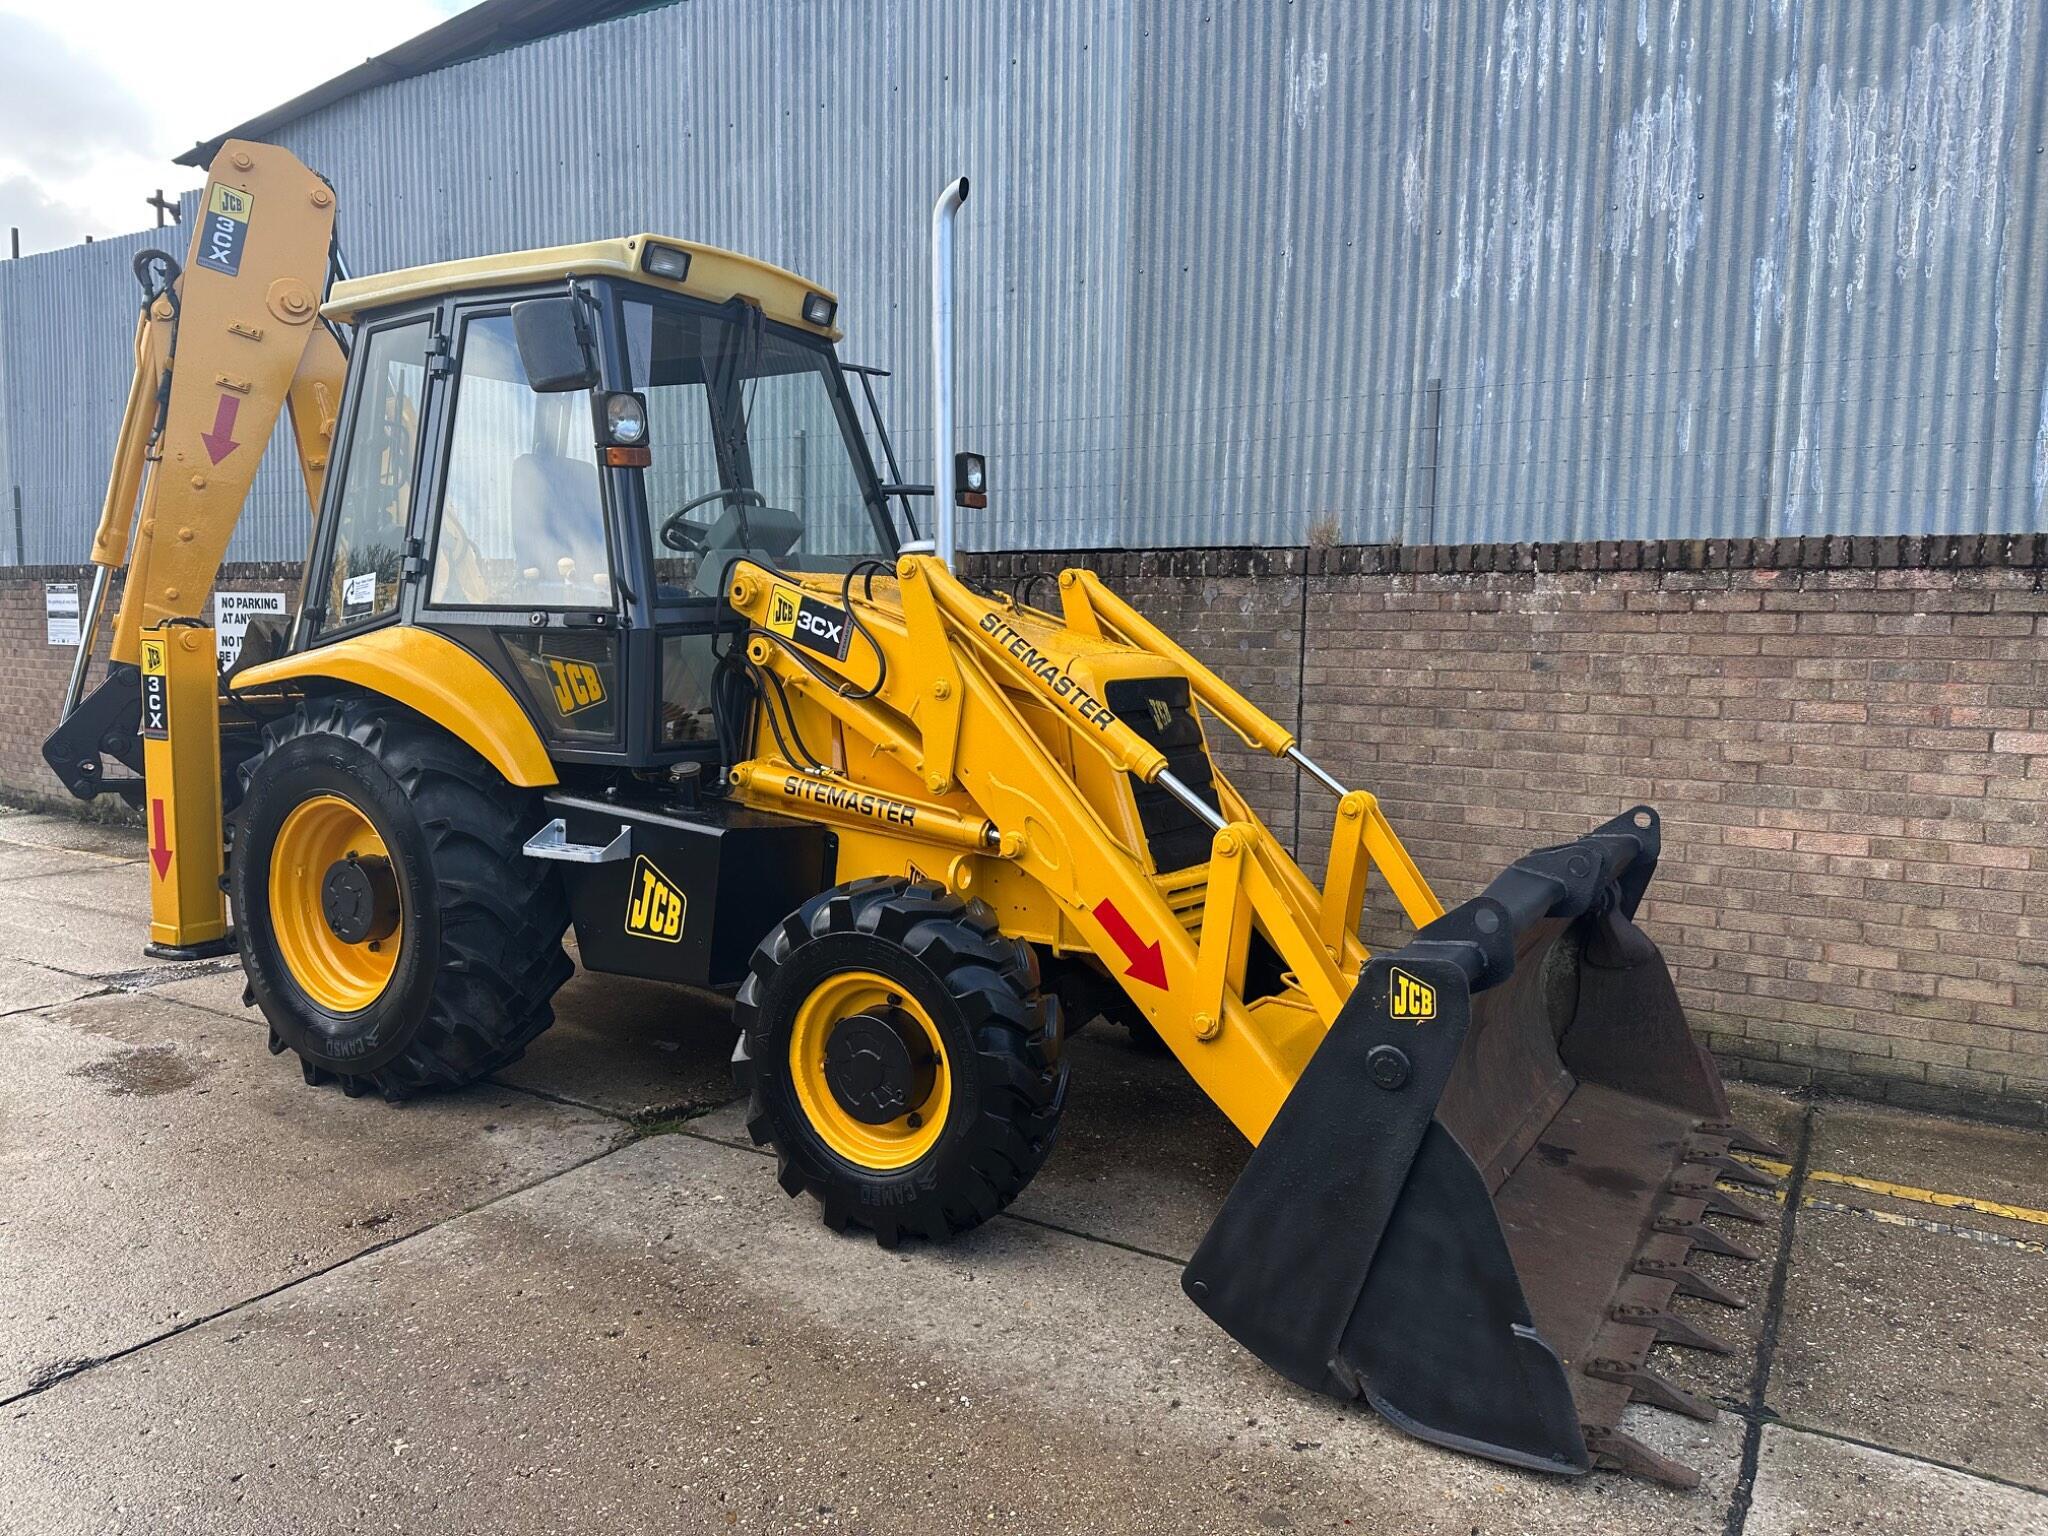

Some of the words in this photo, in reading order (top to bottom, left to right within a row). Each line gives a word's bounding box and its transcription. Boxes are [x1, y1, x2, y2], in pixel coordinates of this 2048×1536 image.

[222, 191, 242, 211] JCB
[208, 216, 235, 264] 3CX
[221, 597, 235, 609] NO
[237, 597, 278, 610] PARKING
[222, 613, 233, 624] AT
[774, 597, 794, 622] JCB
[221, 635, 235, 647] NO
[797, 610, 842, 644] 3CX
[219, 651, 231, 662] BE
[979, 612, 1116, 731] SITEMASTER
[148, 676, 163, 729] 3CX
[550, 659, 602, 712] JCB
[784, 776, 916, 827] SITEMASTER
[630, 868, 682, 936] JCB
[1394, 975, 1432, 1015] JCB
